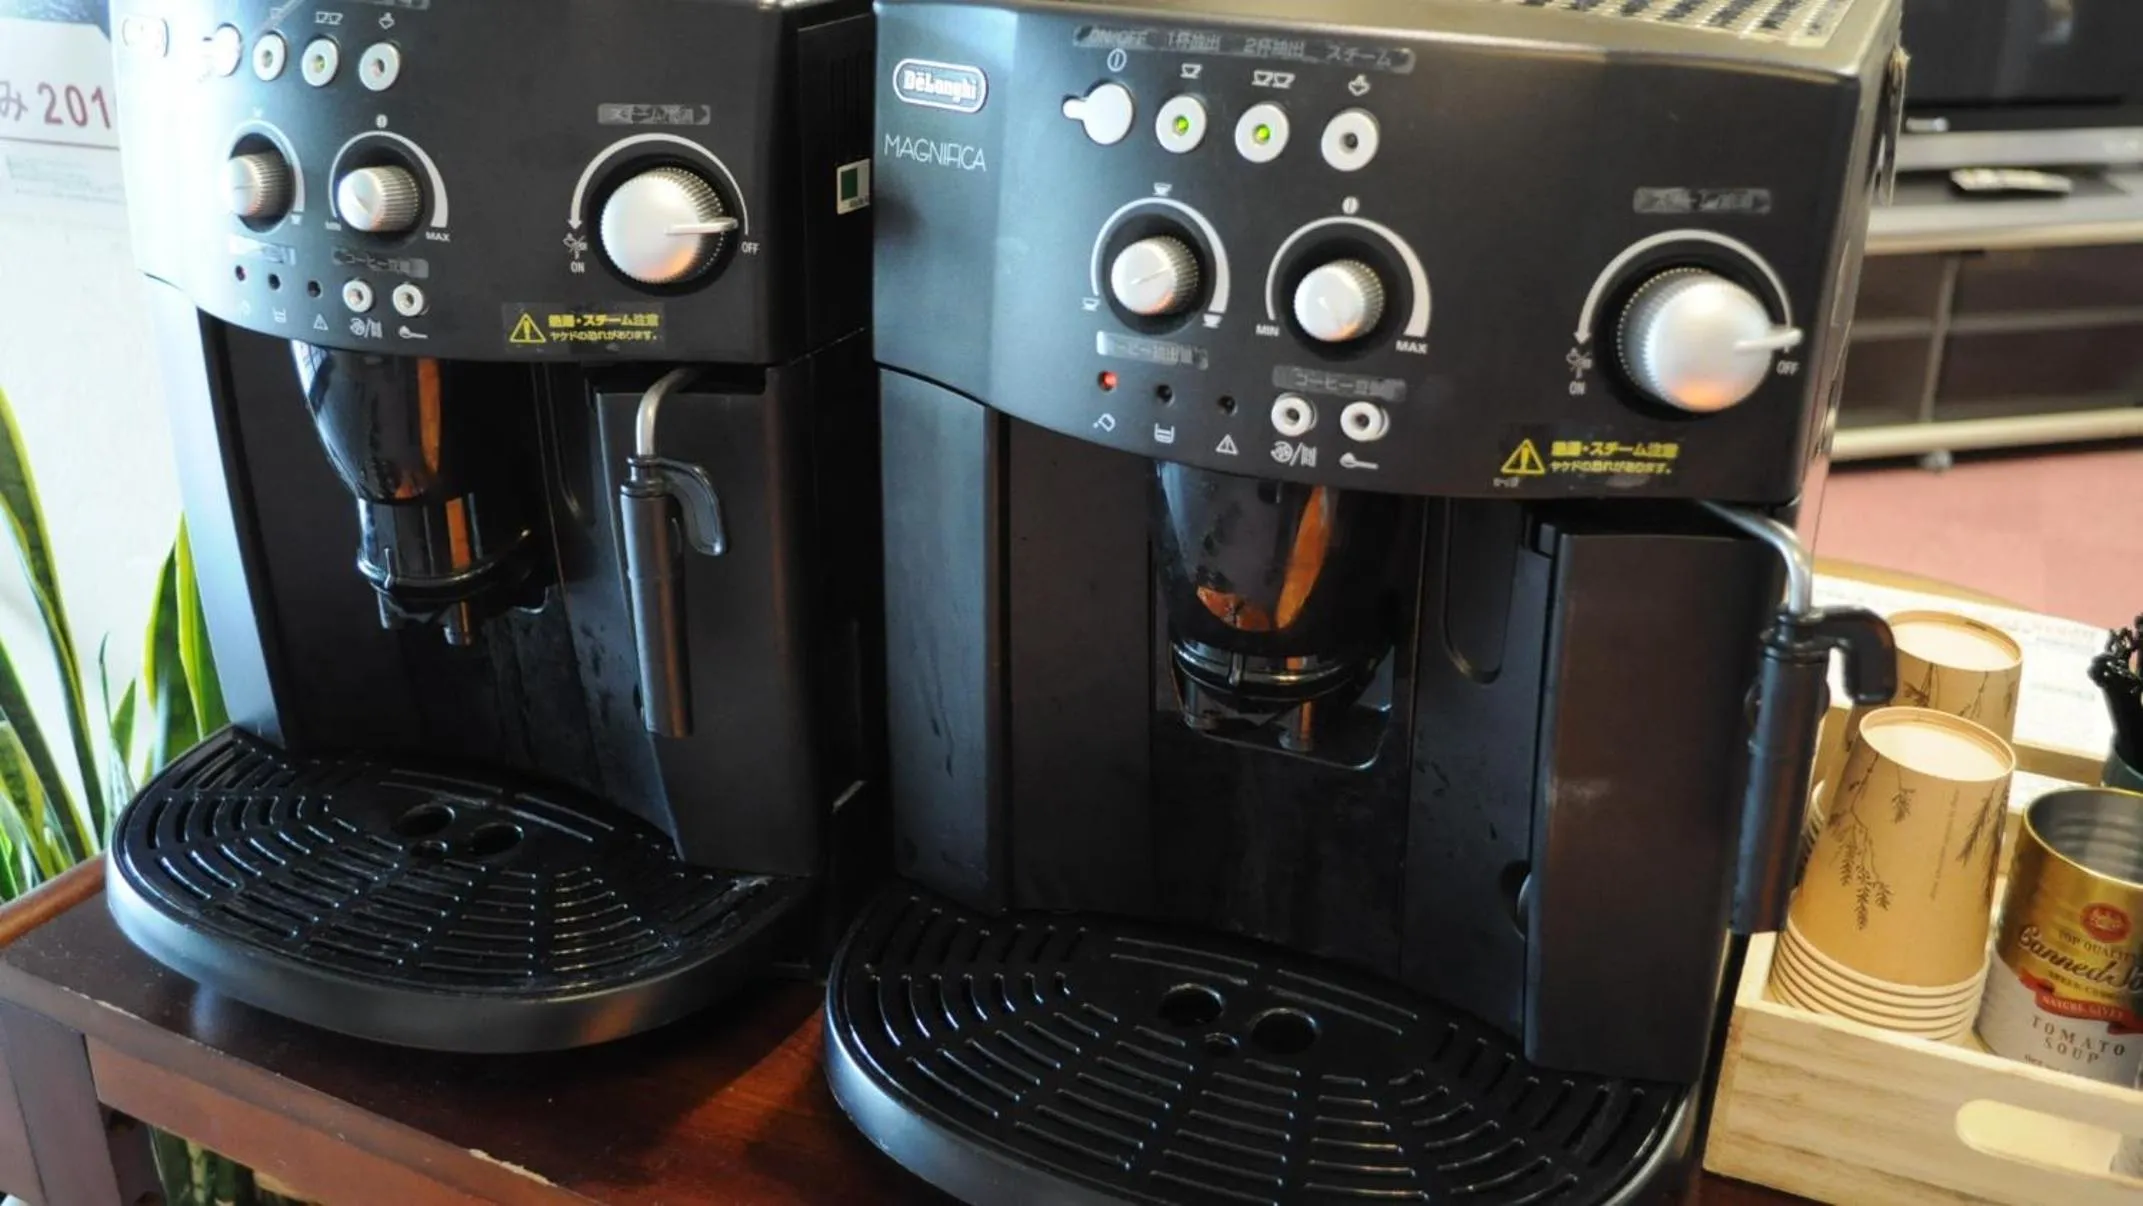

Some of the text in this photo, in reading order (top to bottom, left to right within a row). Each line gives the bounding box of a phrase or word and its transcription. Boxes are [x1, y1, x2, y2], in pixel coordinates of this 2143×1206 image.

[884, 133, 987, 172] MAGNIFICA
[425, 231, 451, 242] MAX
[740, 242, 760, 255] OFF
[570, 262, 585, 273] ON
[1256, 324, 1280, 336] MIN
[1395, 340, 1428, 354] MAX
[1776, 360, 1799, 375] OFF
[1569, 381, 1586, 396] ON
[2058, 928, 2081, 945] TOP
[2020, 925, 2118, 984] Canned
[2031, 1015, 2126, 1056] TOMATO
[2044, 1037, 2100, 1064] SOUP
